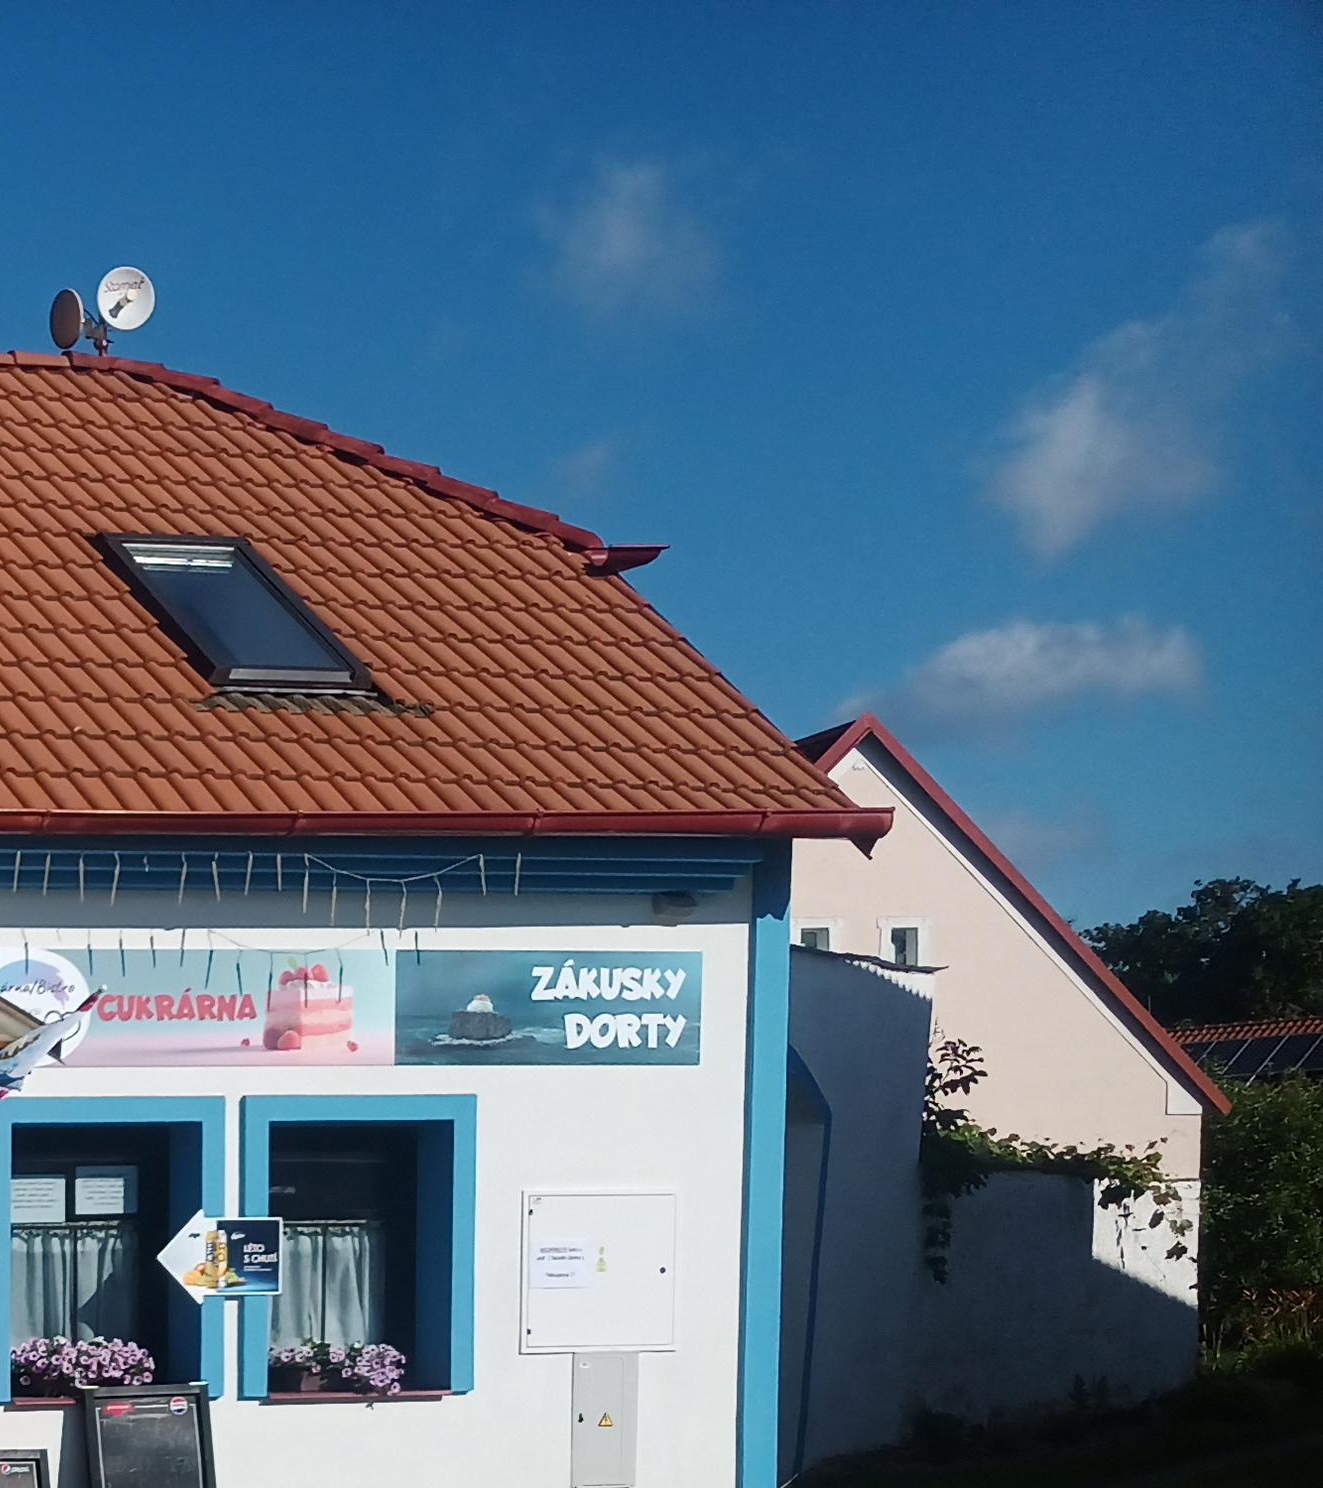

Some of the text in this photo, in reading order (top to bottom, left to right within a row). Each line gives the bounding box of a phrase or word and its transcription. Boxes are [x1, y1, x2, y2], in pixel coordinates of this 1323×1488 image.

[530, 959, 687, 1000] ZÁKUSKY
[95, 988, 258, 1022] CUKRÁRNA
[563, 1013, 687, 1049] DORTY
